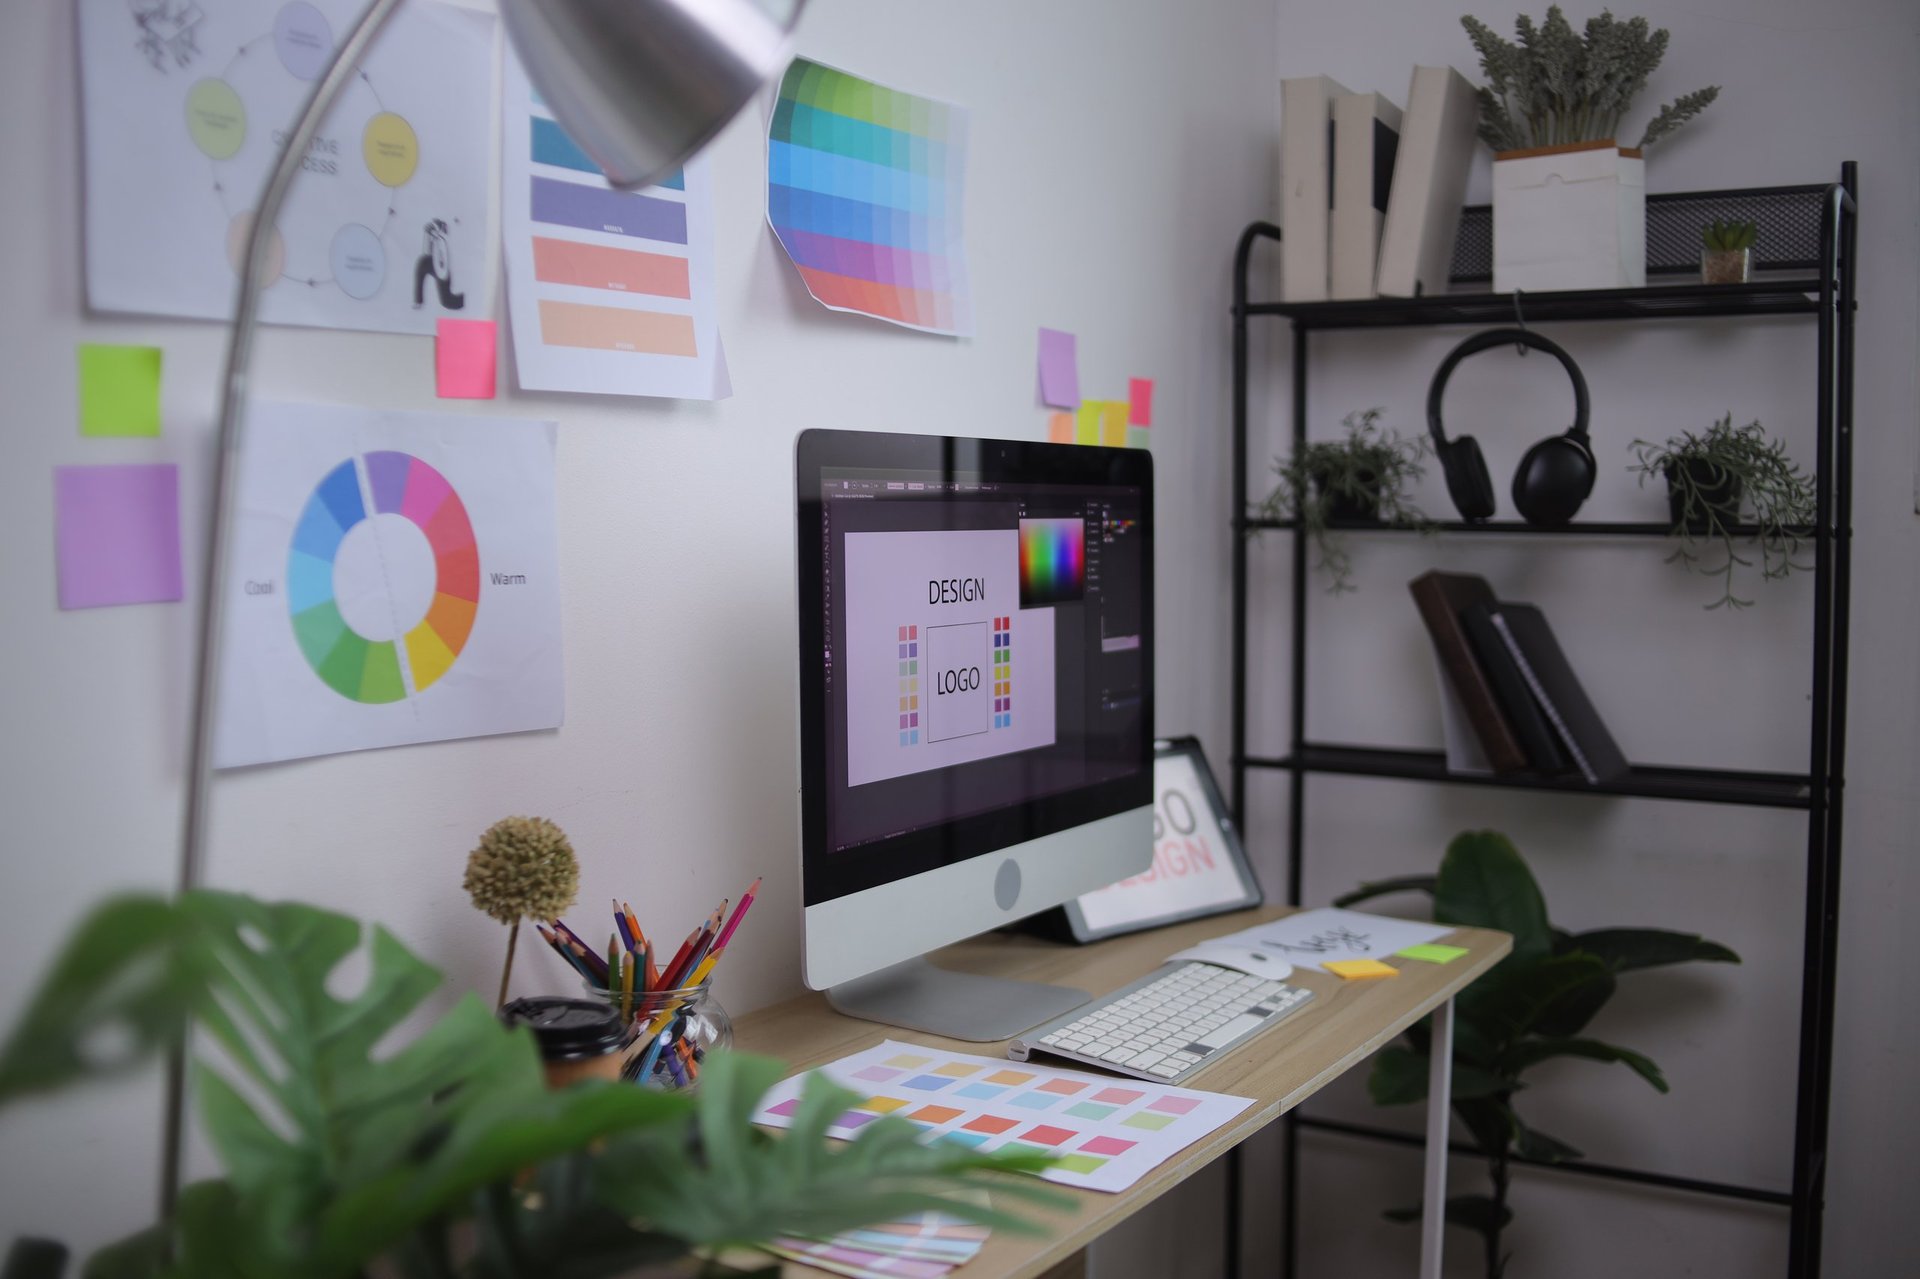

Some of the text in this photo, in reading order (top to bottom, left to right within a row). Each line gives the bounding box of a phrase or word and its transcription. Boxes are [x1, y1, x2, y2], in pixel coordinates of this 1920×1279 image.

[300, 154, 338, 175] CESS
[489, 572, 527, 586] Warm
[929, 577, 985, 605] DESIGN
[937, 666, 980, 695] LOGO
